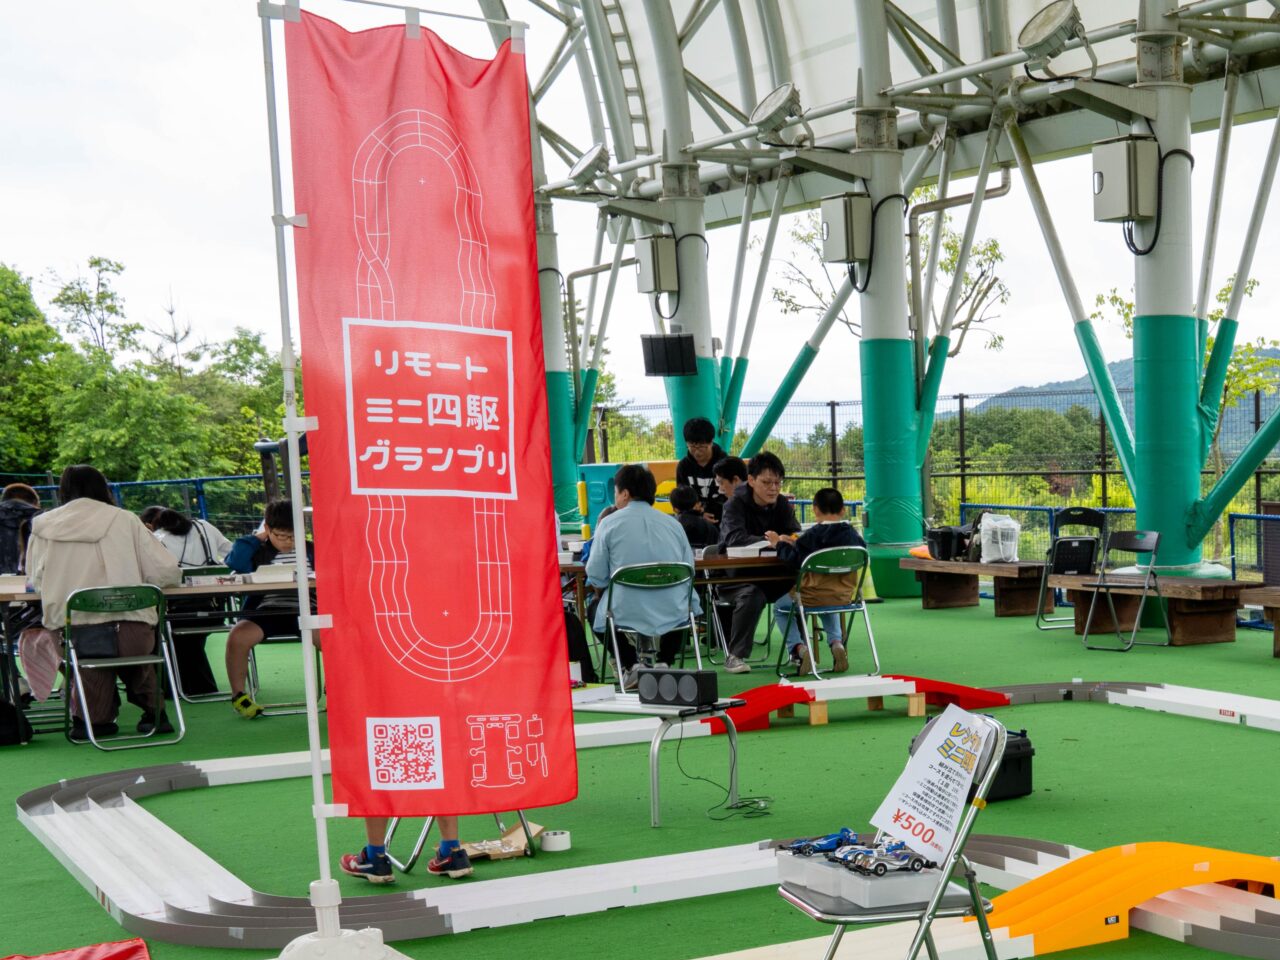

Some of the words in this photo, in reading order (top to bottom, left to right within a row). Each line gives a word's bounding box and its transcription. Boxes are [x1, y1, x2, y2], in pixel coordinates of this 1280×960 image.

[375, 350, 488, 380] リモート
[366, 393, 500, 431] ミニ四駆
[359, 439, 507, 475] グランプリ
[892, 808, 935, 844] ¥500
